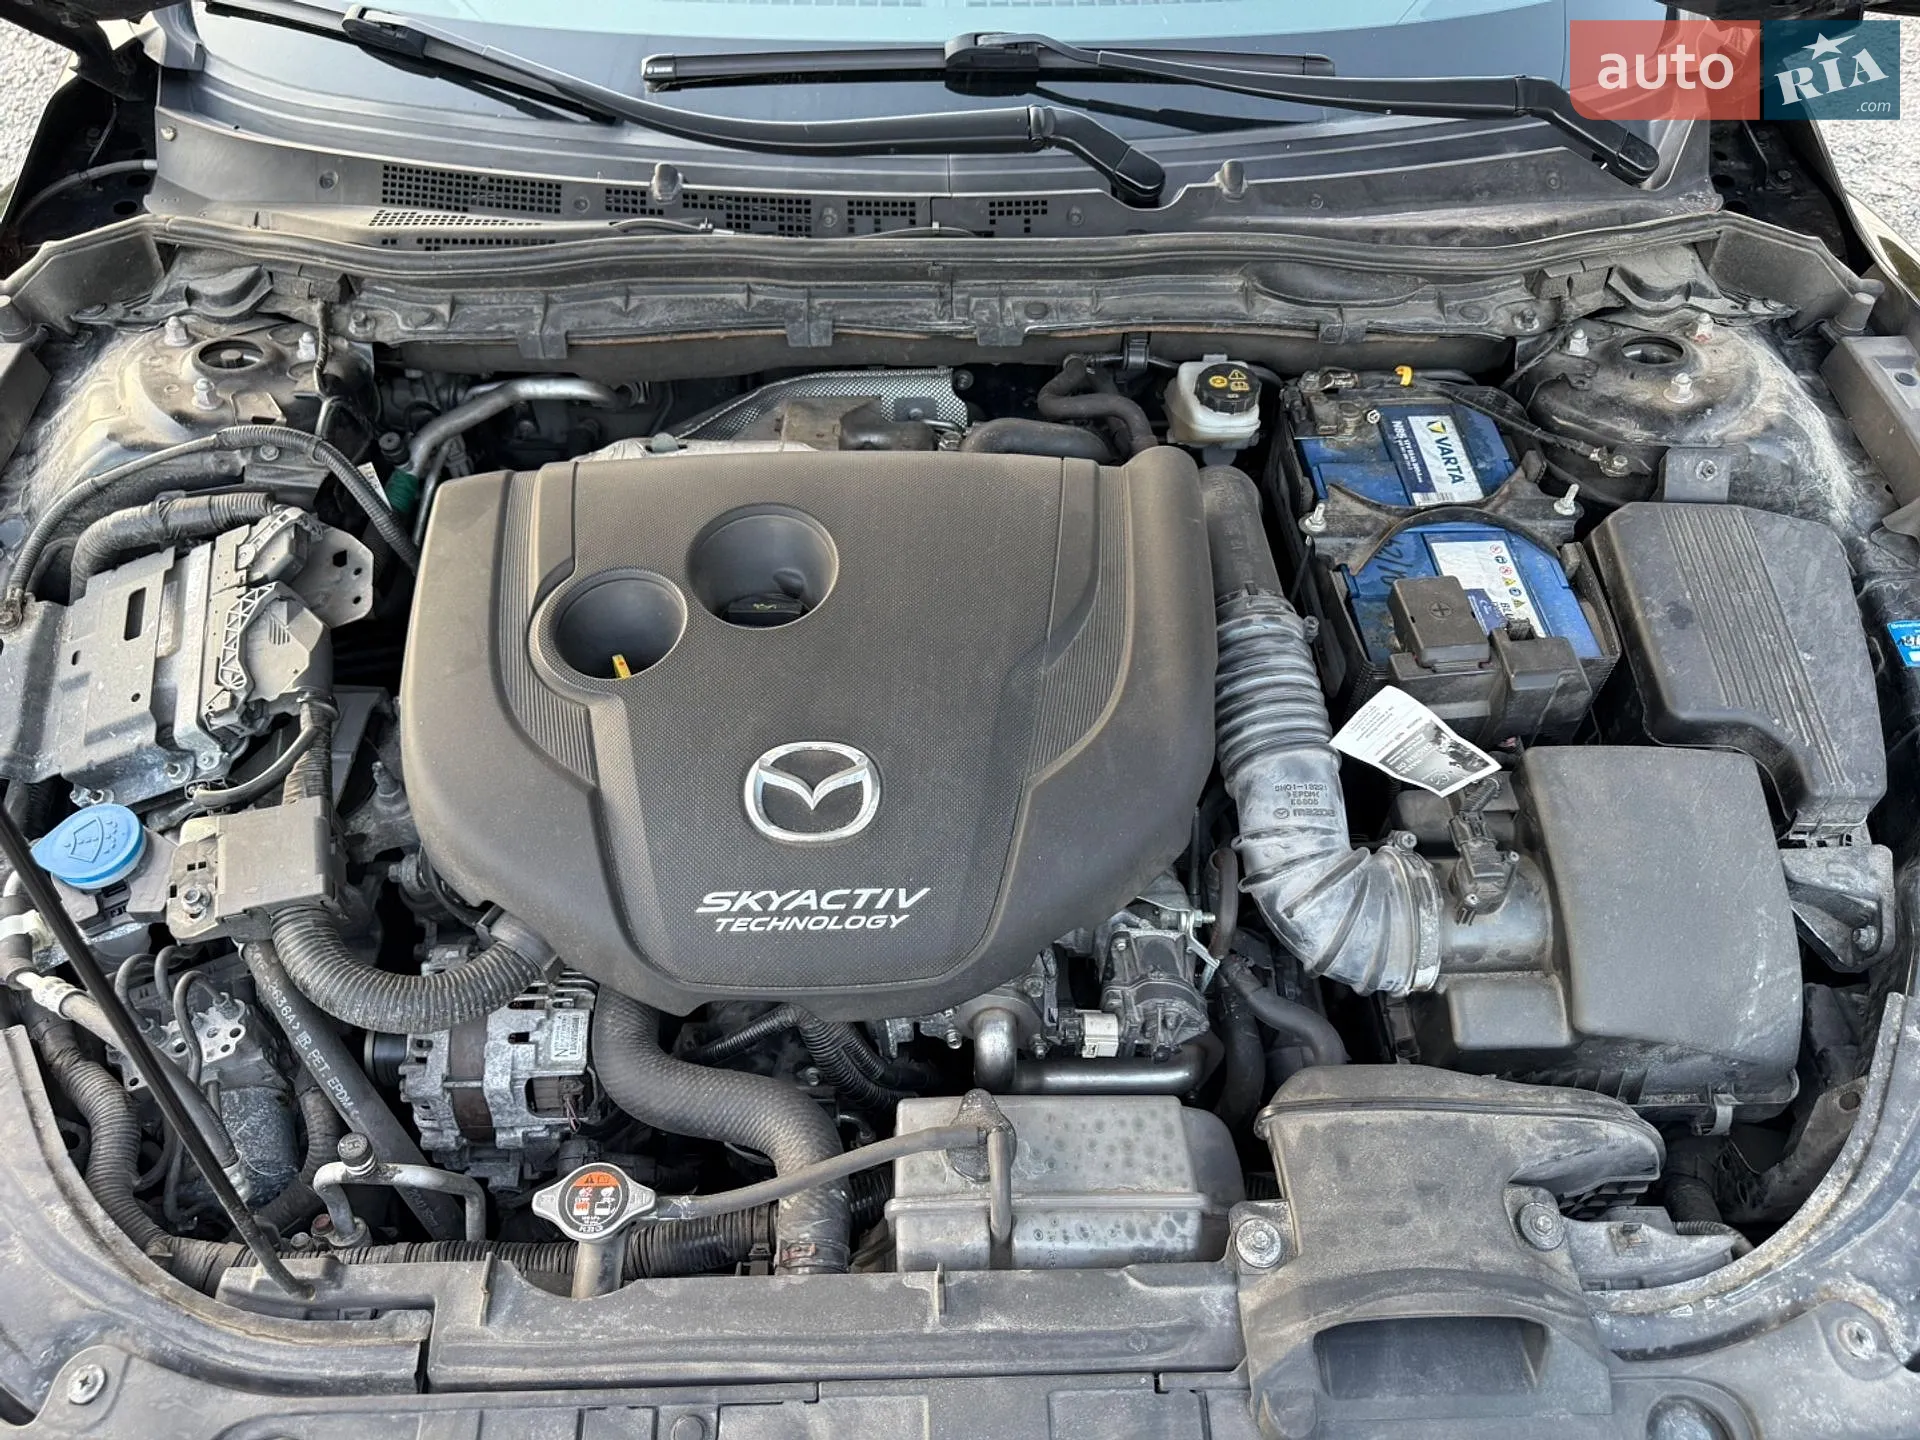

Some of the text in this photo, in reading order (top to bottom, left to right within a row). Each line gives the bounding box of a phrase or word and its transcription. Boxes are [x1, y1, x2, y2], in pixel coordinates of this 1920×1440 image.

[1435, 437, 1465, 484] VARTA
[696, 887, 931, 914] SKYACTIV
[715, 914, 909, 933] TECHNOLOGY
